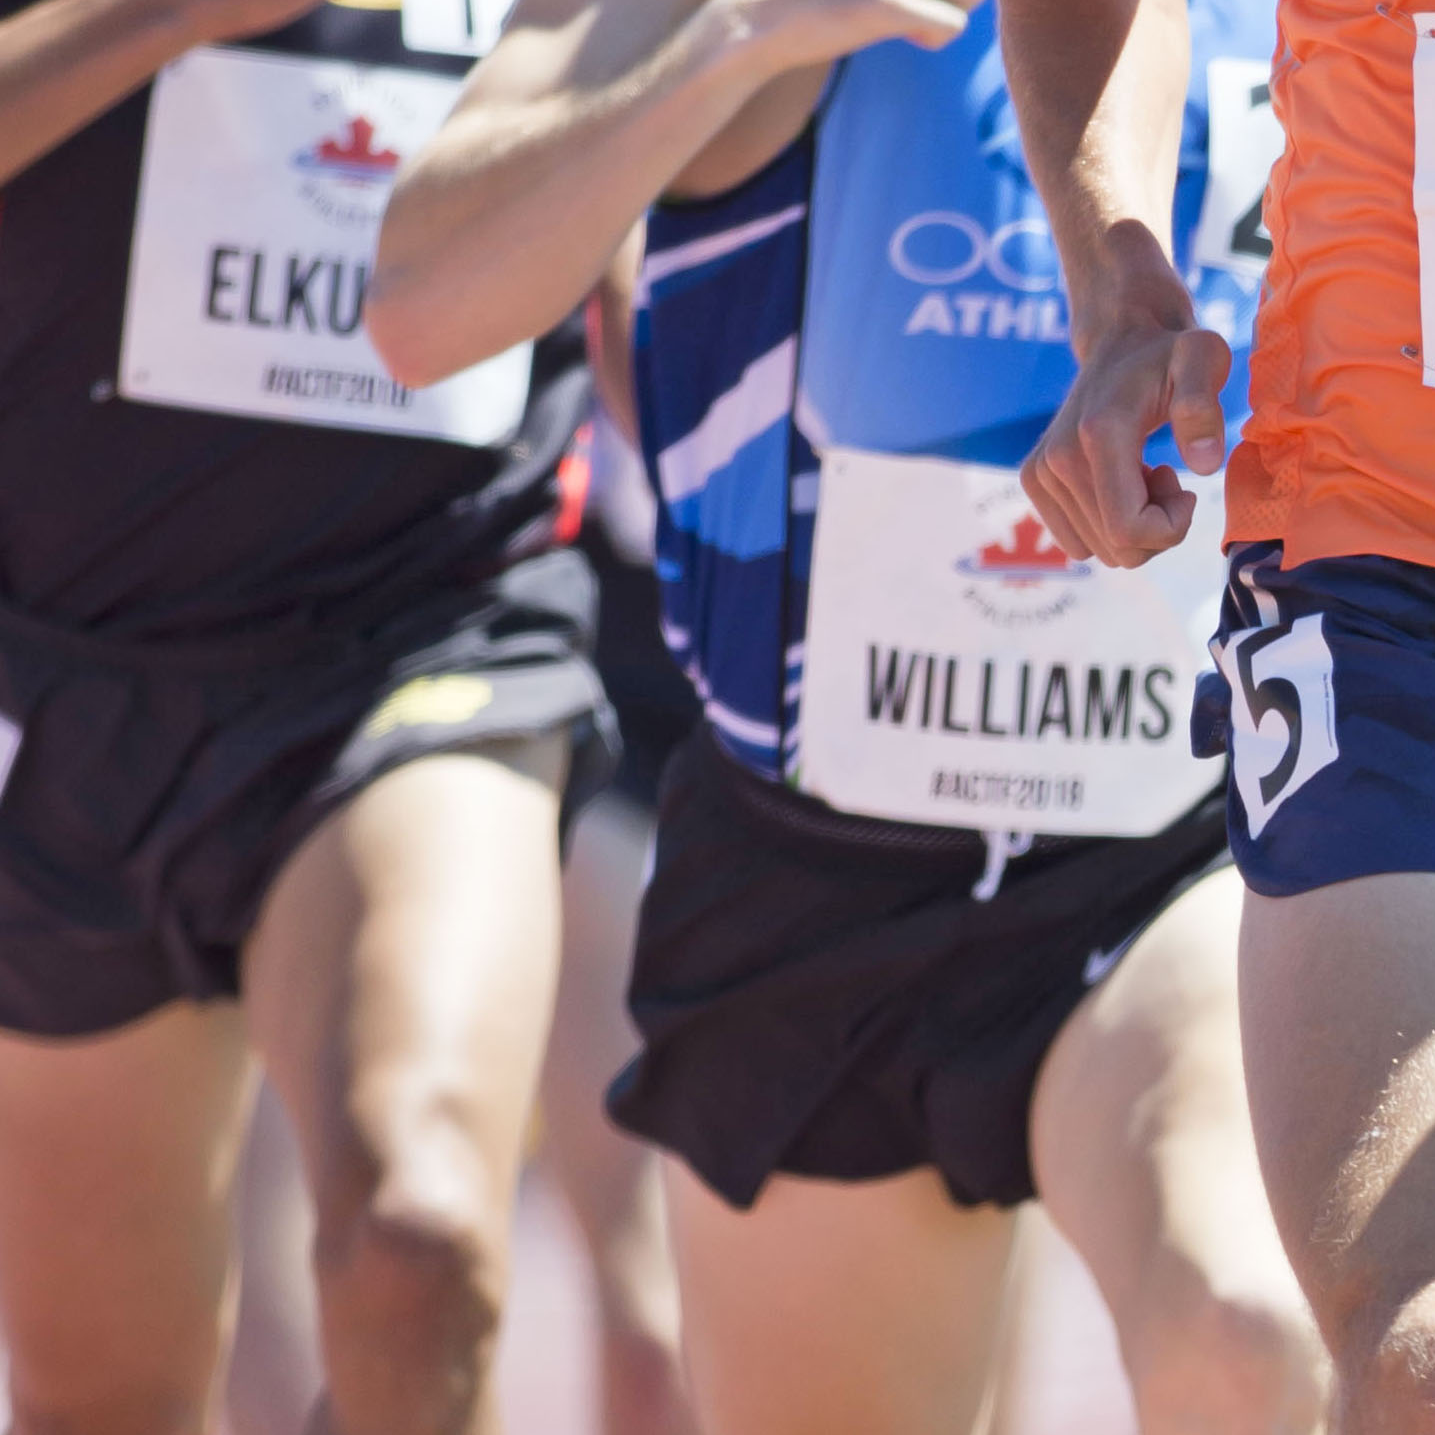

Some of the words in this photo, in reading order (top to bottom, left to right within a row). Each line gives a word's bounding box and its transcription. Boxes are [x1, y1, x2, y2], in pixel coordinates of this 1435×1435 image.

[206, 243, 368, 337] ELKU
[866, 642, 1176, 743] WILLIAMS
[1236, 622, 1303, 807] 5
[928, 768, 1084, 809] #ACTF2018
